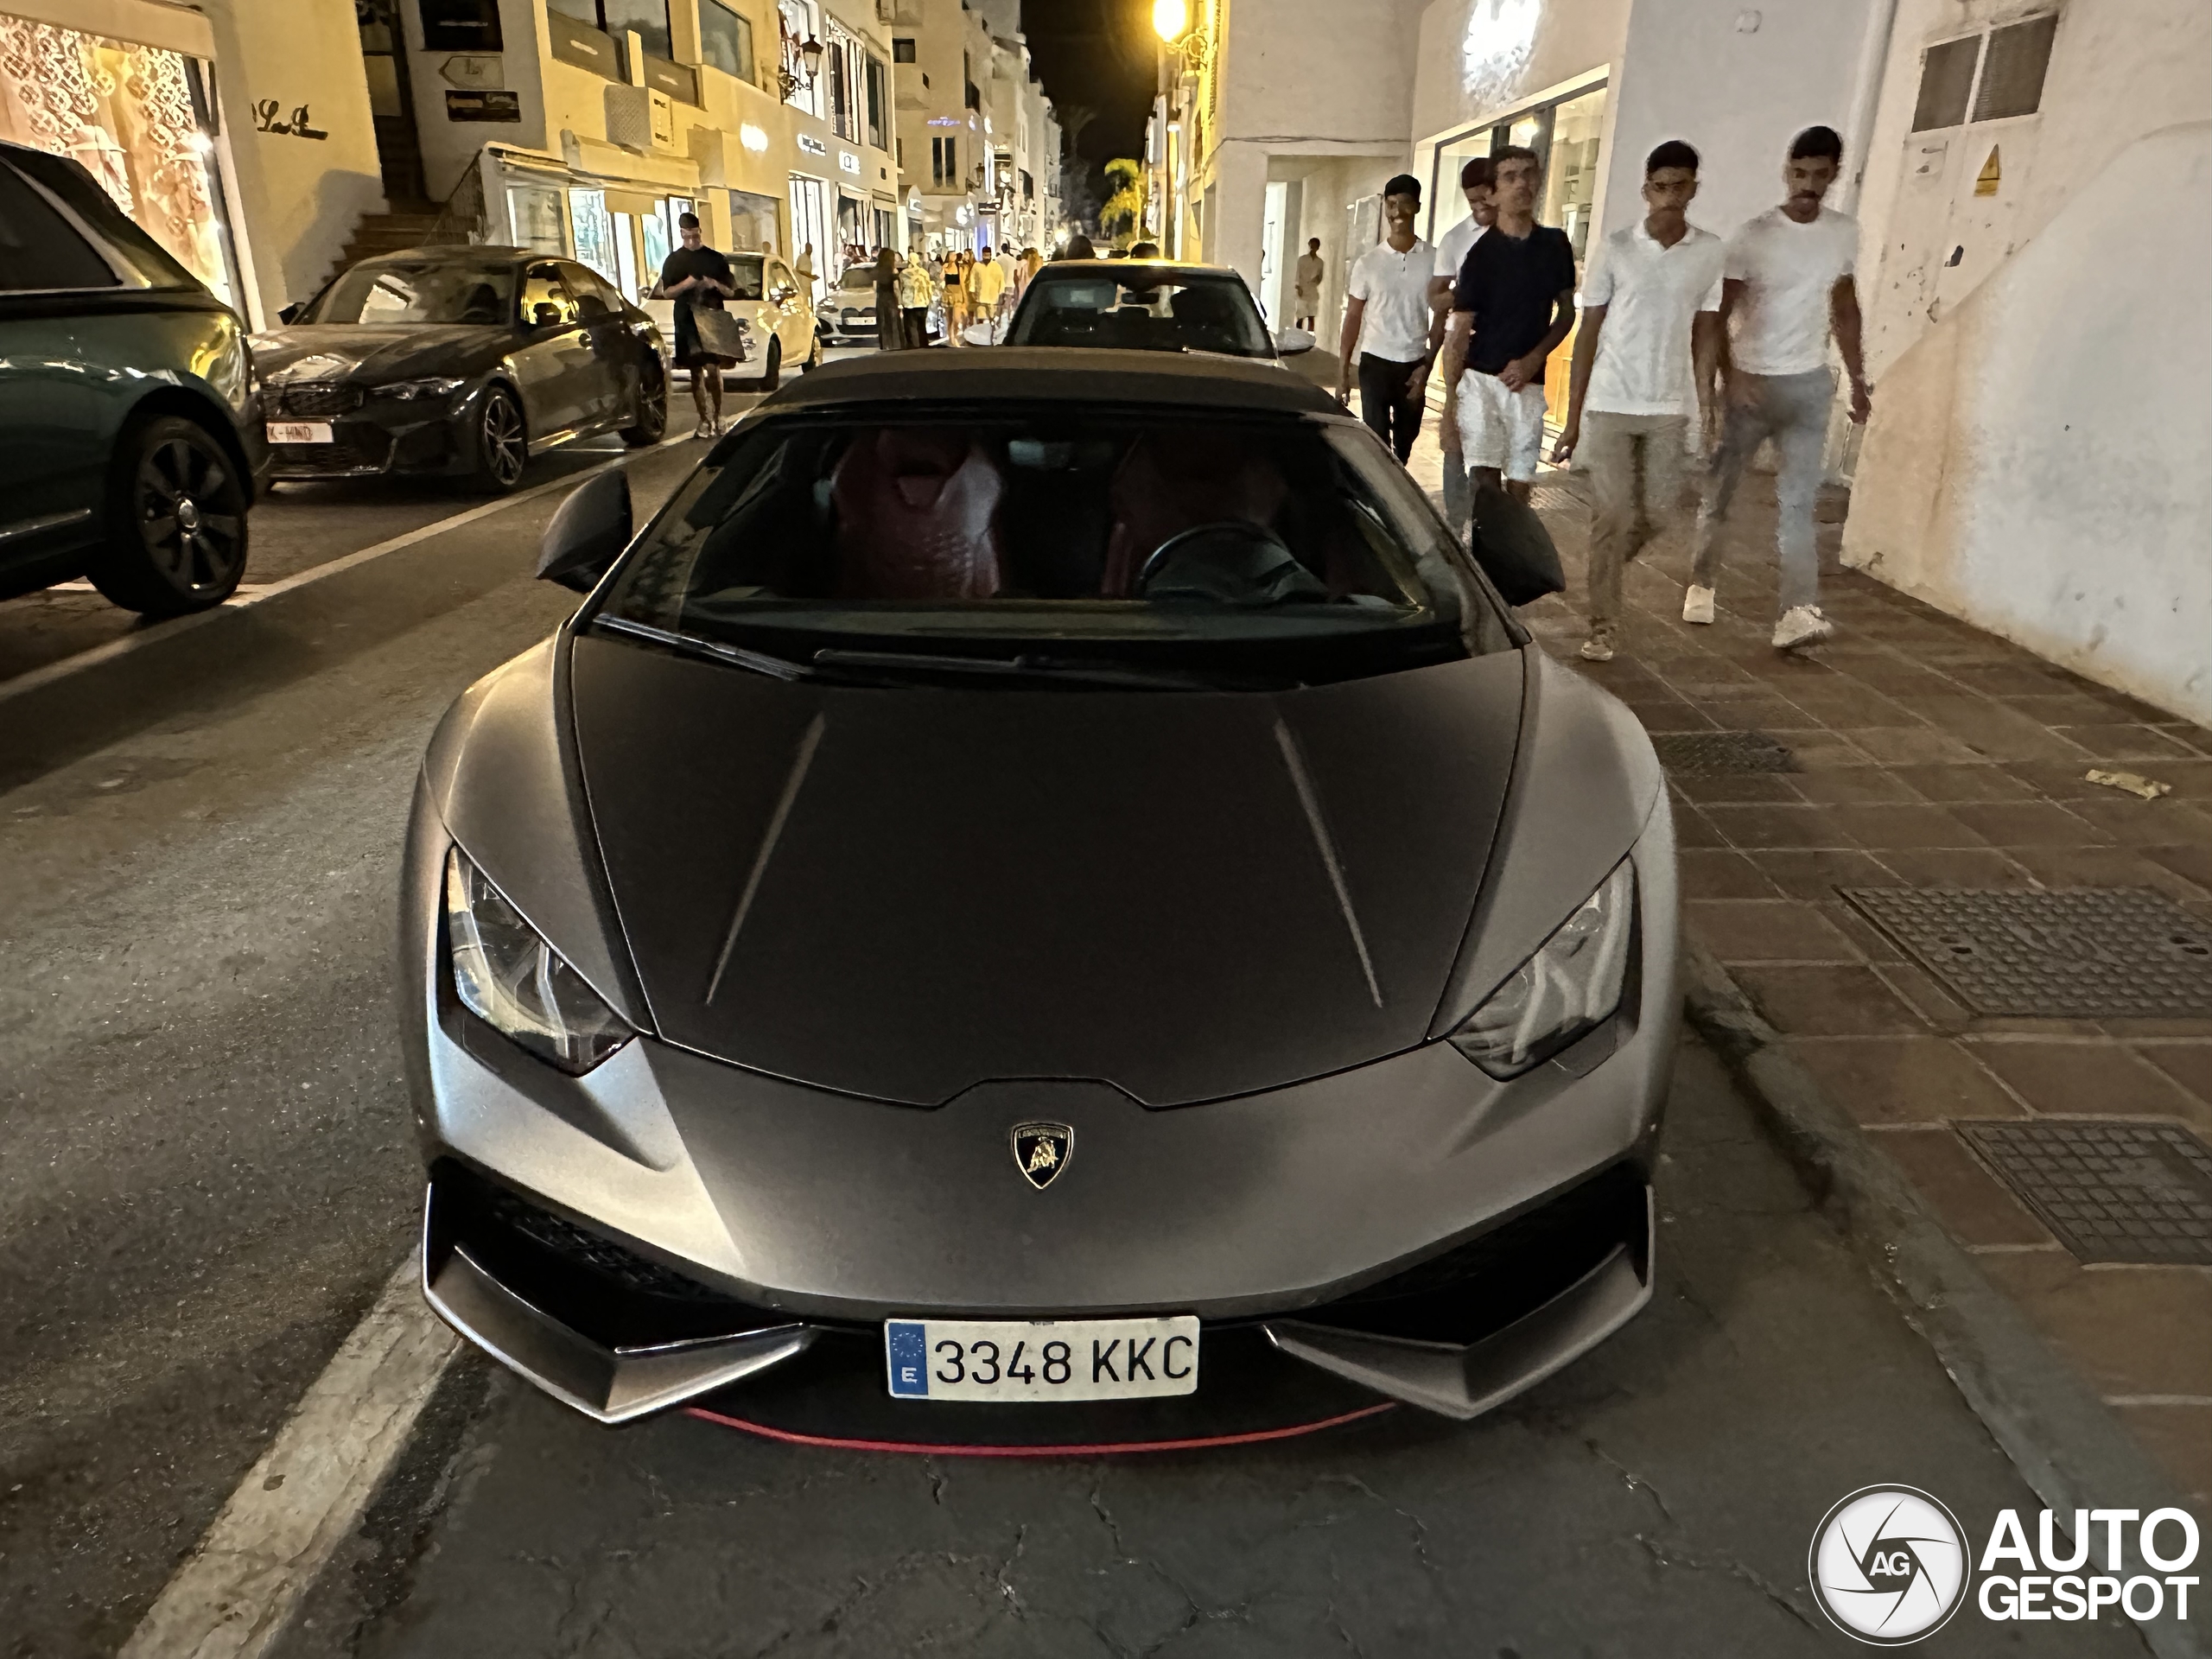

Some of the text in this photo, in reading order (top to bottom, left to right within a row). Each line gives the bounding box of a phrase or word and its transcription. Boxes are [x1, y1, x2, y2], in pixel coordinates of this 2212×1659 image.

[901, 1366, 918, 1384] E
[934, 1335, 1193, 1385] 3348 KKC
